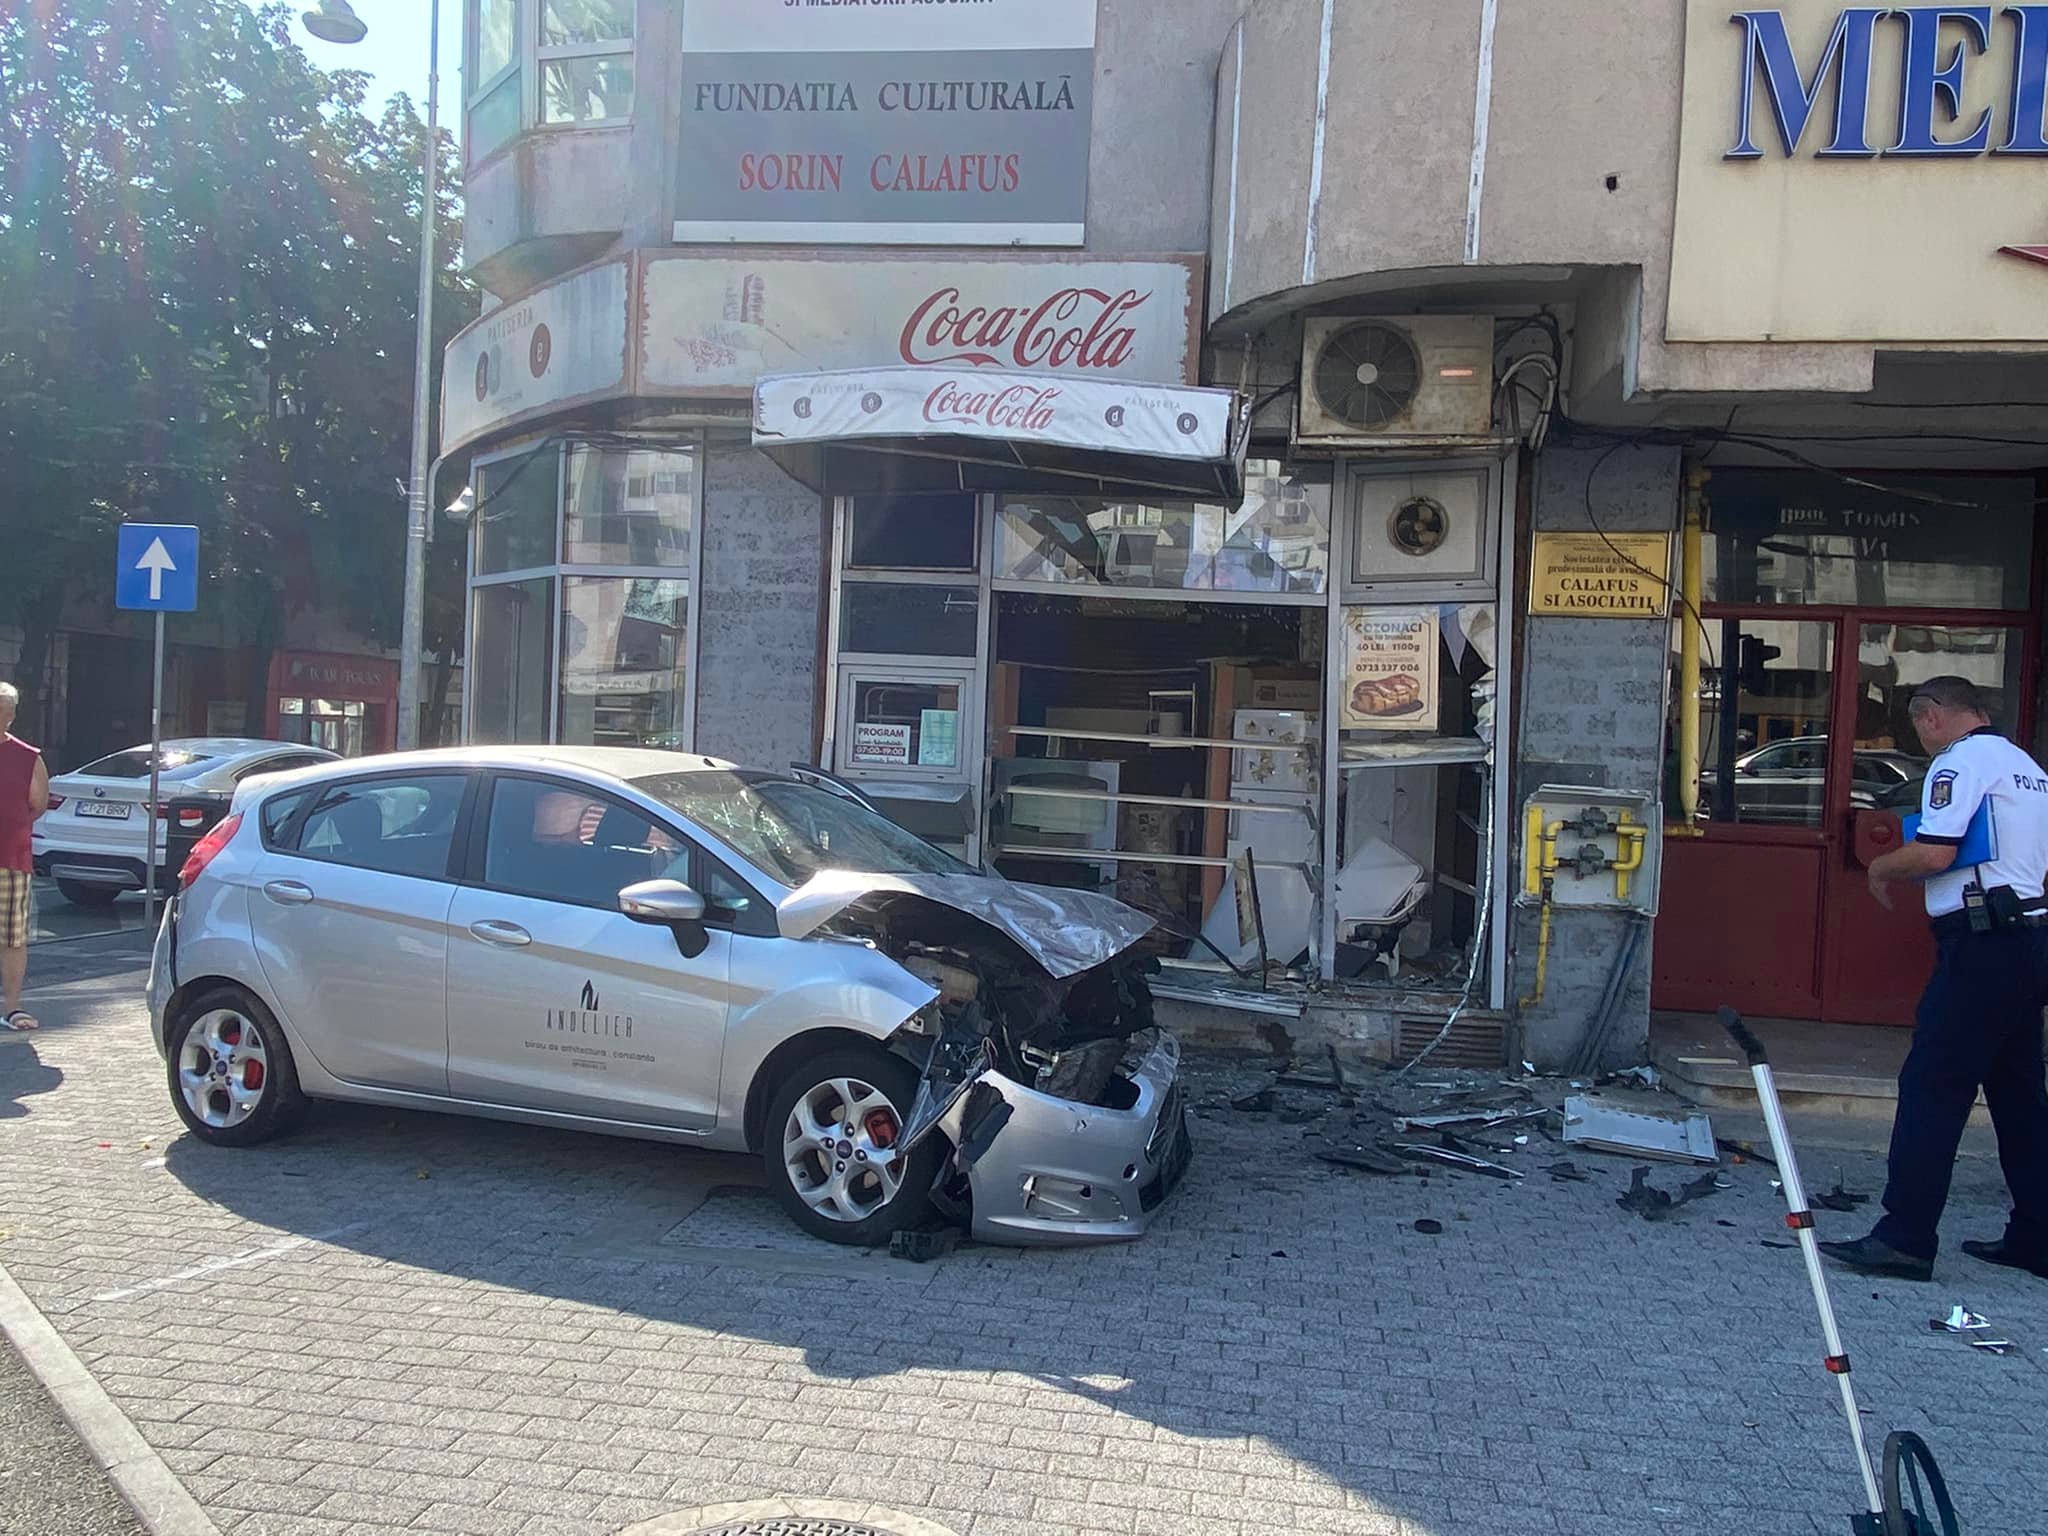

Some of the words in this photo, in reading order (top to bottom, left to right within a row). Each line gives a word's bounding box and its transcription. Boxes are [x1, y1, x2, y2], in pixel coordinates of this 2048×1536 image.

[695, 81, 859, 113] FUNDATIA
[739, 153, 843, 193] SORIN
[869, 152, 1020, 193] CALAFUS
[900, 287, 1153, 369] Coca-Cola
[922, 380, 1063, 430] Coca-Cola
[1605, 564, 1617, 574] de
[1560, 578, 1639, 592] CALAFUS
[1543, 594, 1561, 607] SI
[1355, 622, 1422, 633] COZONACI
[858, 727, 904, 737] PROGRAM
